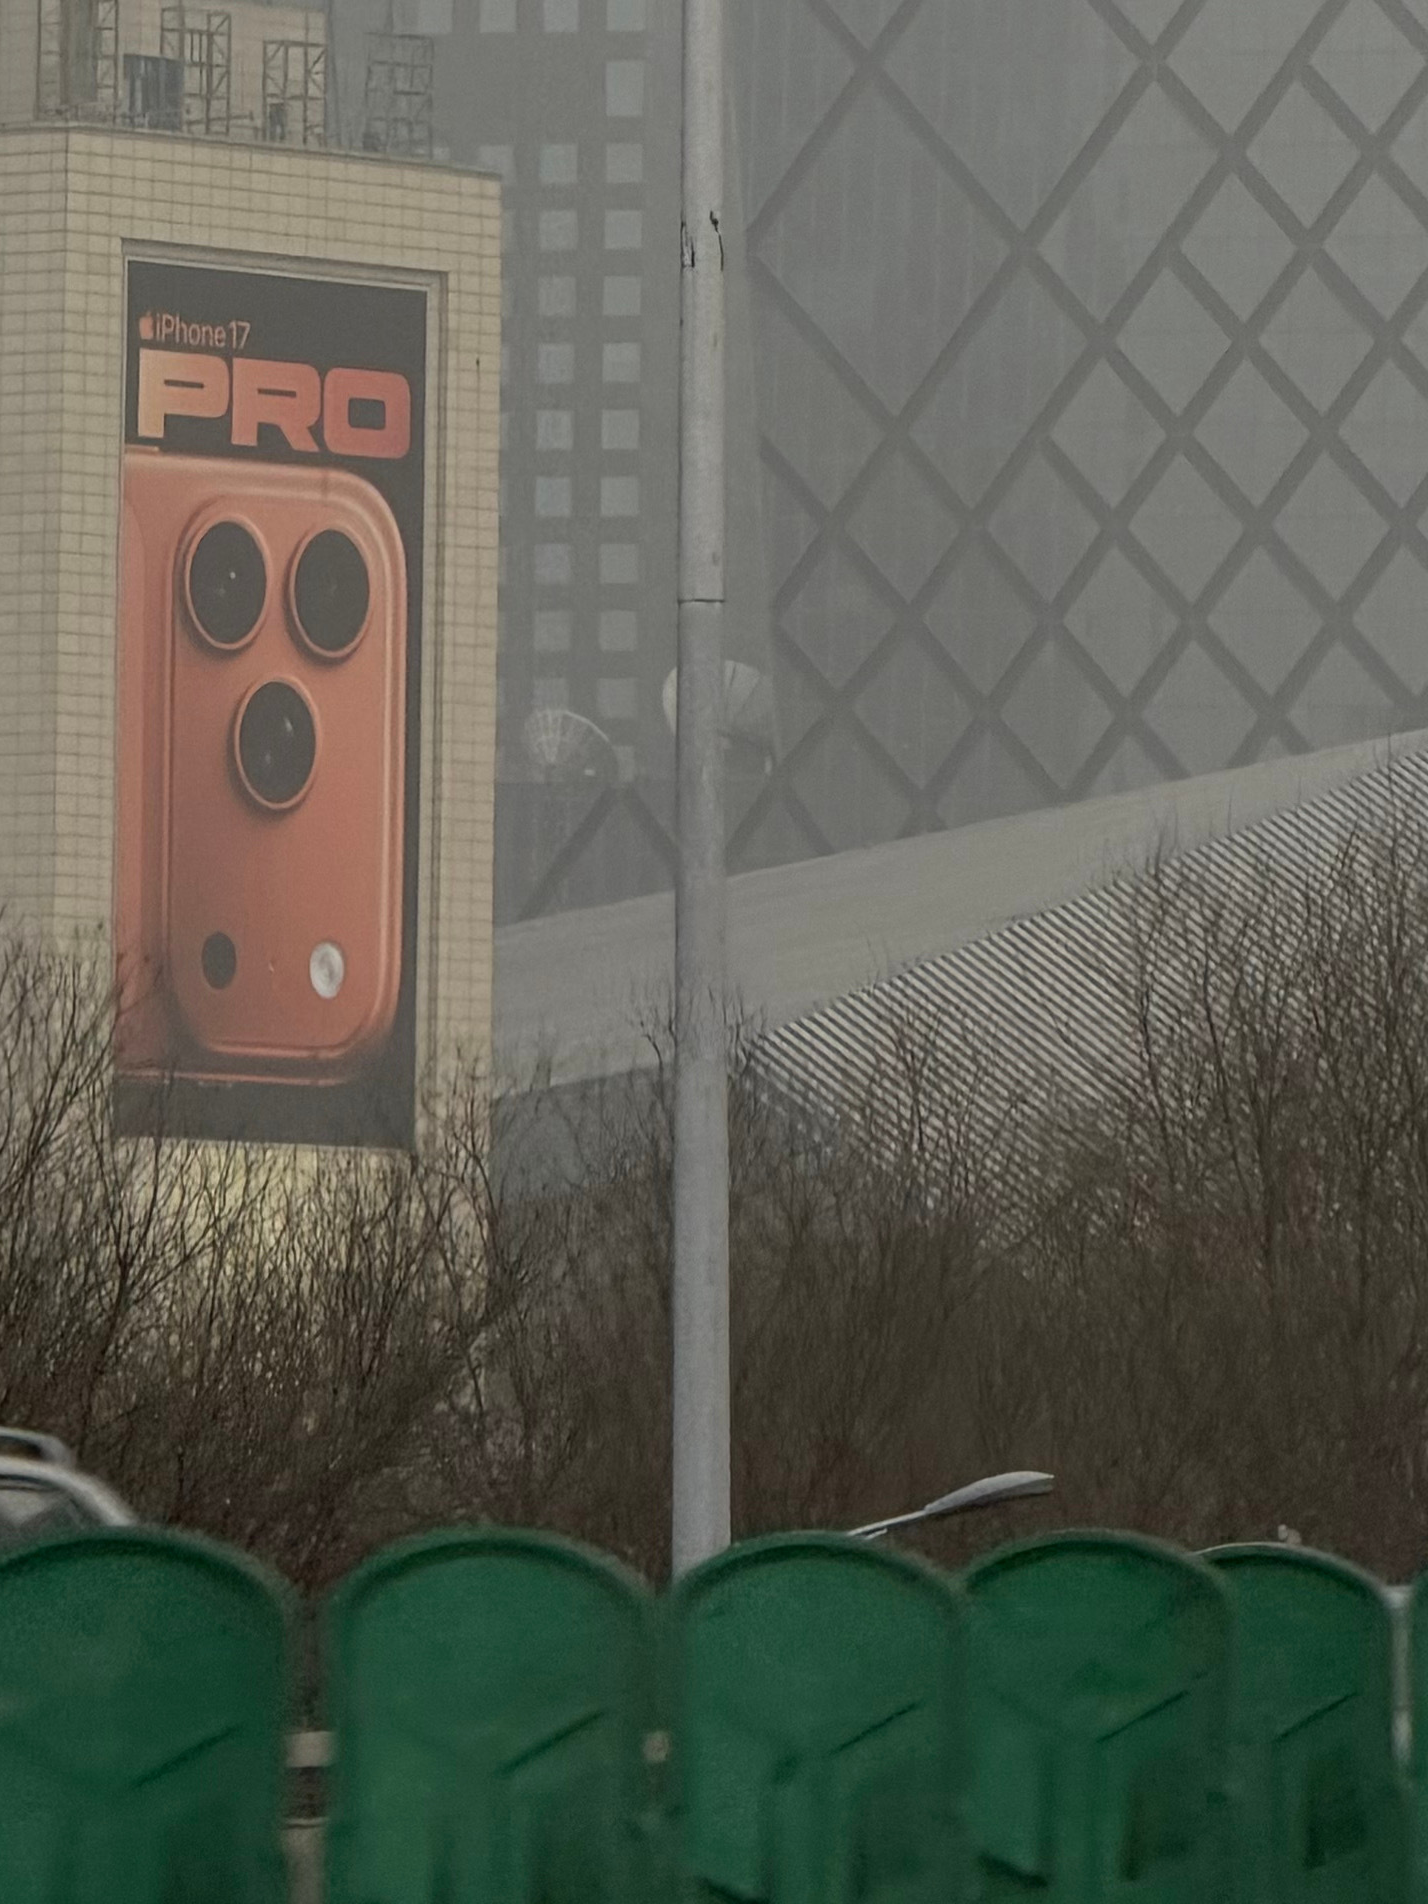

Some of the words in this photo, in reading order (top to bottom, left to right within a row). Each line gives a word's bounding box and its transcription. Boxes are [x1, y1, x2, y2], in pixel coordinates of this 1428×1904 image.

[155, 313, 227, 347] iPhone
[230, 321, 251, 349] 17
[137, 348, 411, 459] PRO
